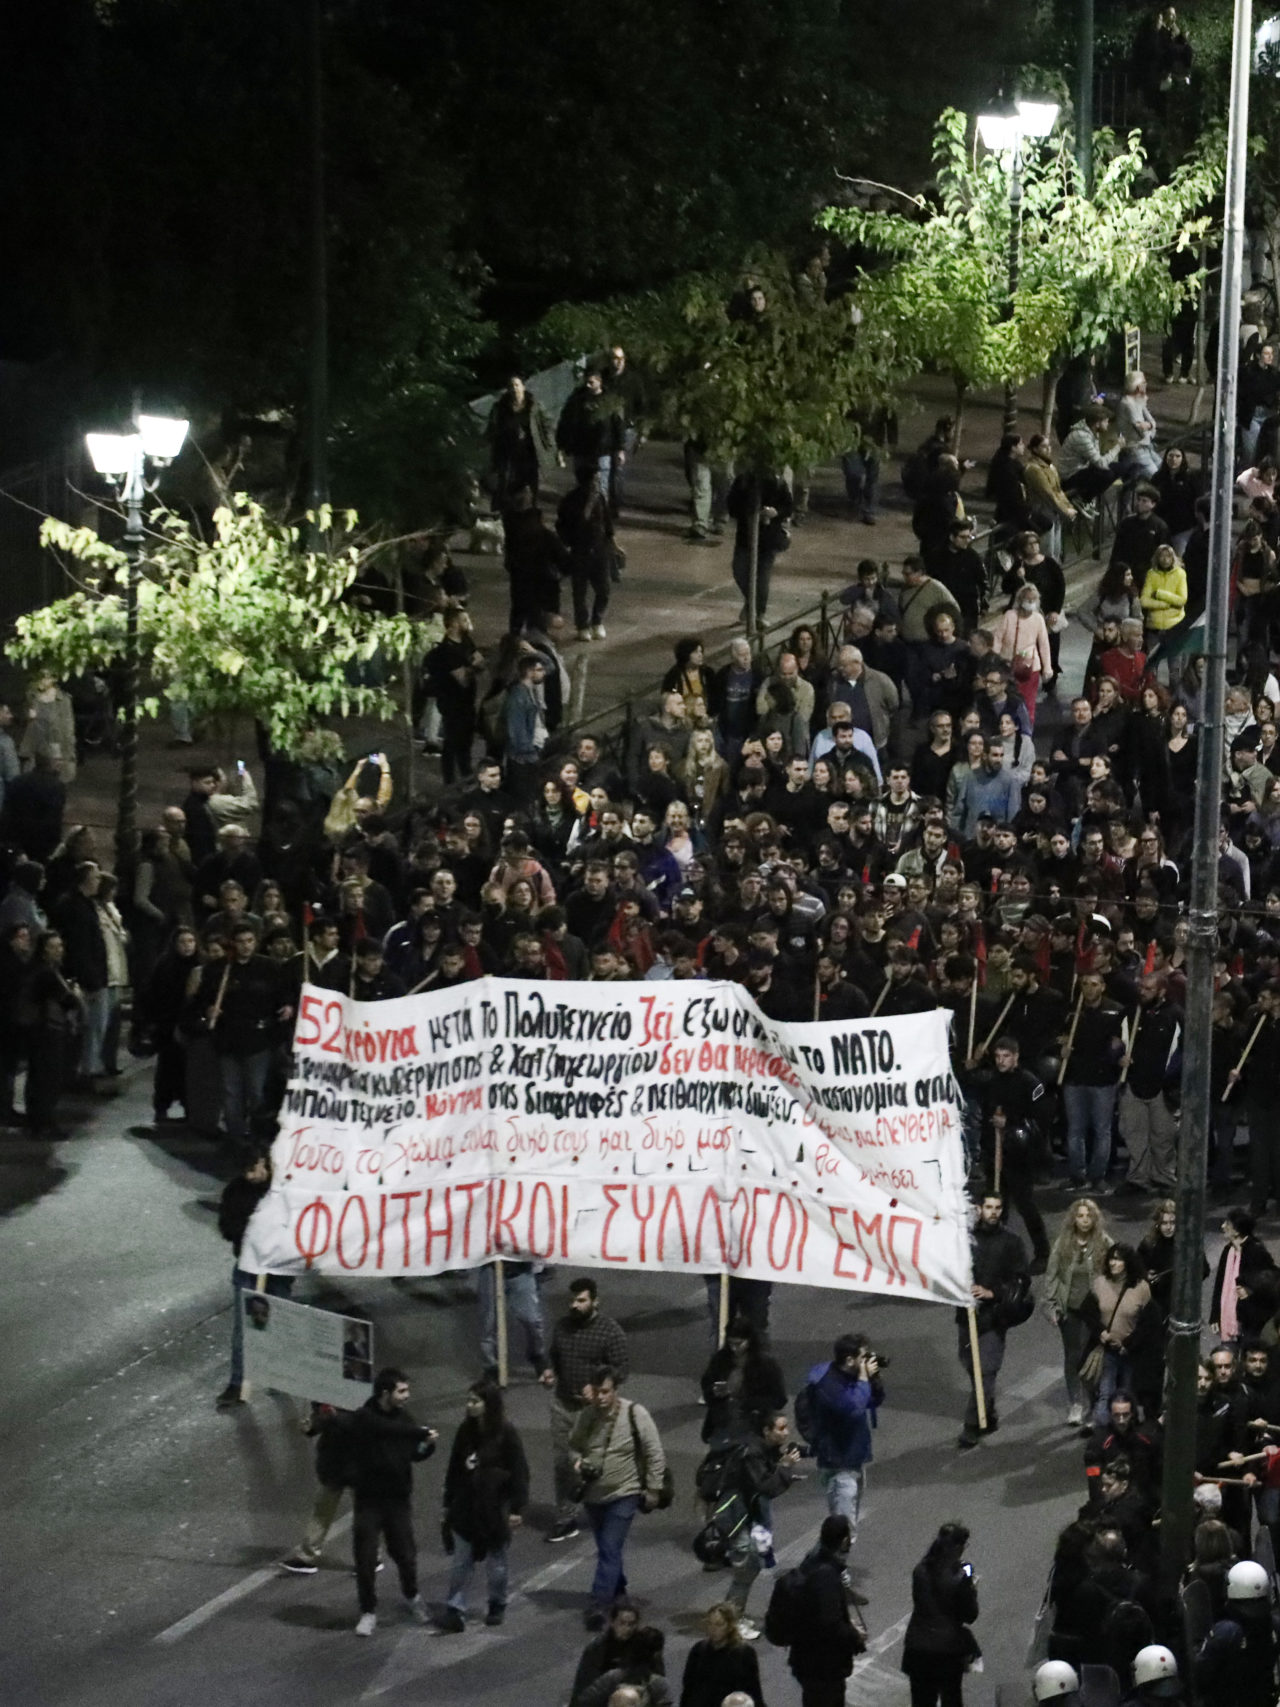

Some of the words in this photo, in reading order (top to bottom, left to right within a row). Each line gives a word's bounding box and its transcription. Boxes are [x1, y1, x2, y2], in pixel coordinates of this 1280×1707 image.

[297, 995, 343, 1054] 52
[343, 1020, 420, 1063] χρόνια
[505, 990, 632, 1042] Πολυτεχνείο
[488, 1043, 505, 1075] &
[658, 1041, 696, 1076] δεν
[697, 1040, 730, 1073] θα
[630, 1083, 646, 1117] &
[356, 1148, 384, 1175] το
[697, 1125, 734, 1160] μας
[295, 1178, 570, 1271] ΦΟΙΤΗΤΙΚΟΙ
[601, 1183, 809, 1272] ΣΥΛΛΟΓΟΙ
[829, 1205, 929, 1290] ΕΜΠ
